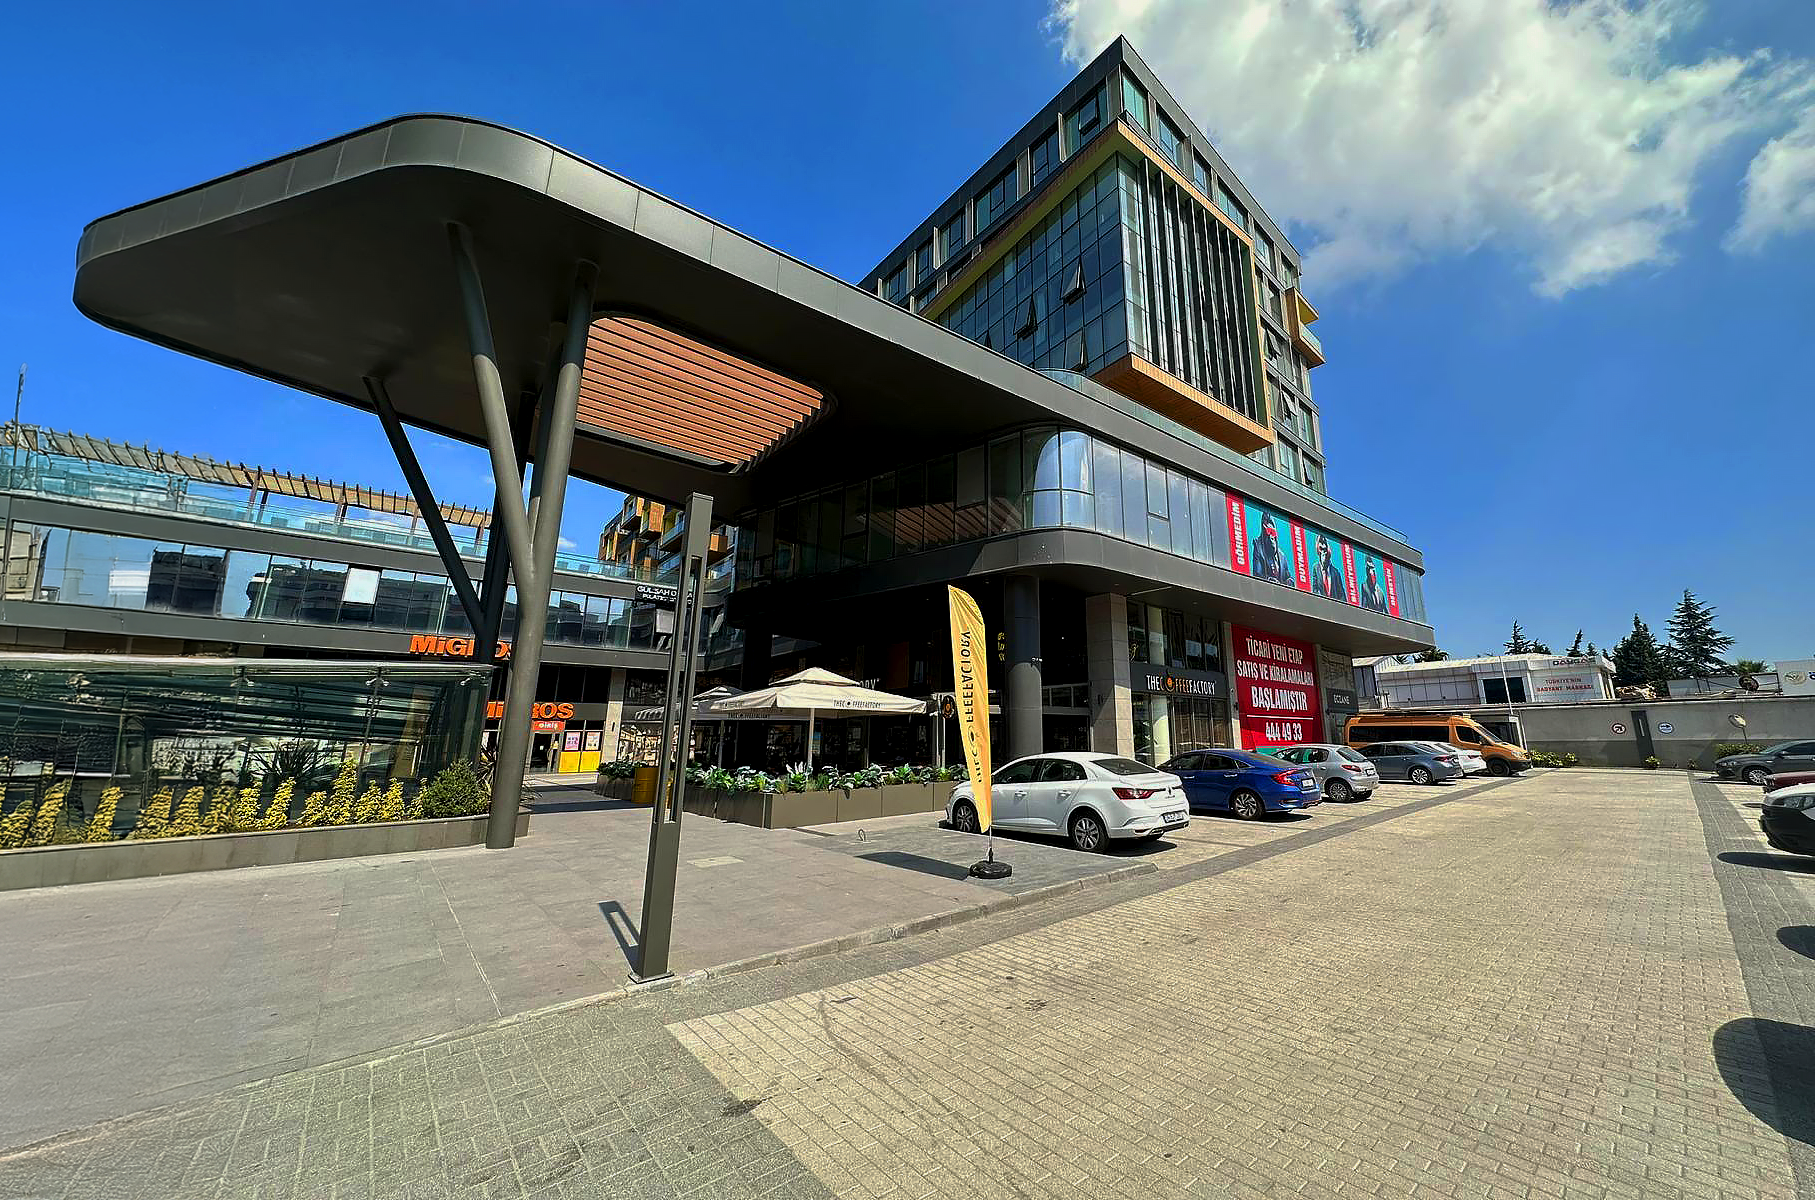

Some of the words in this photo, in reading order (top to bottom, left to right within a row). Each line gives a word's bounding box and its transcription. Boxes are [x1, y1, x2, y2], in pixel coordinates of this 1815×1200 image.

[1245, 634, 1271, 659] TİCARİ
[1271, 643, 1288, 663] YENİ
[1287, 647, 1304, 665] ETAP
[1236, 659, 1259, 681] SATIŞ
[1258, 662, 1270, 680] VE
[1251, 685, 1308, 713] BAŞLAMIŞTIR
[1265, 721, 1281, 741] 444
[1281, 722, 1292, 741] 49
[1292, 722, 1303, 741] 33
